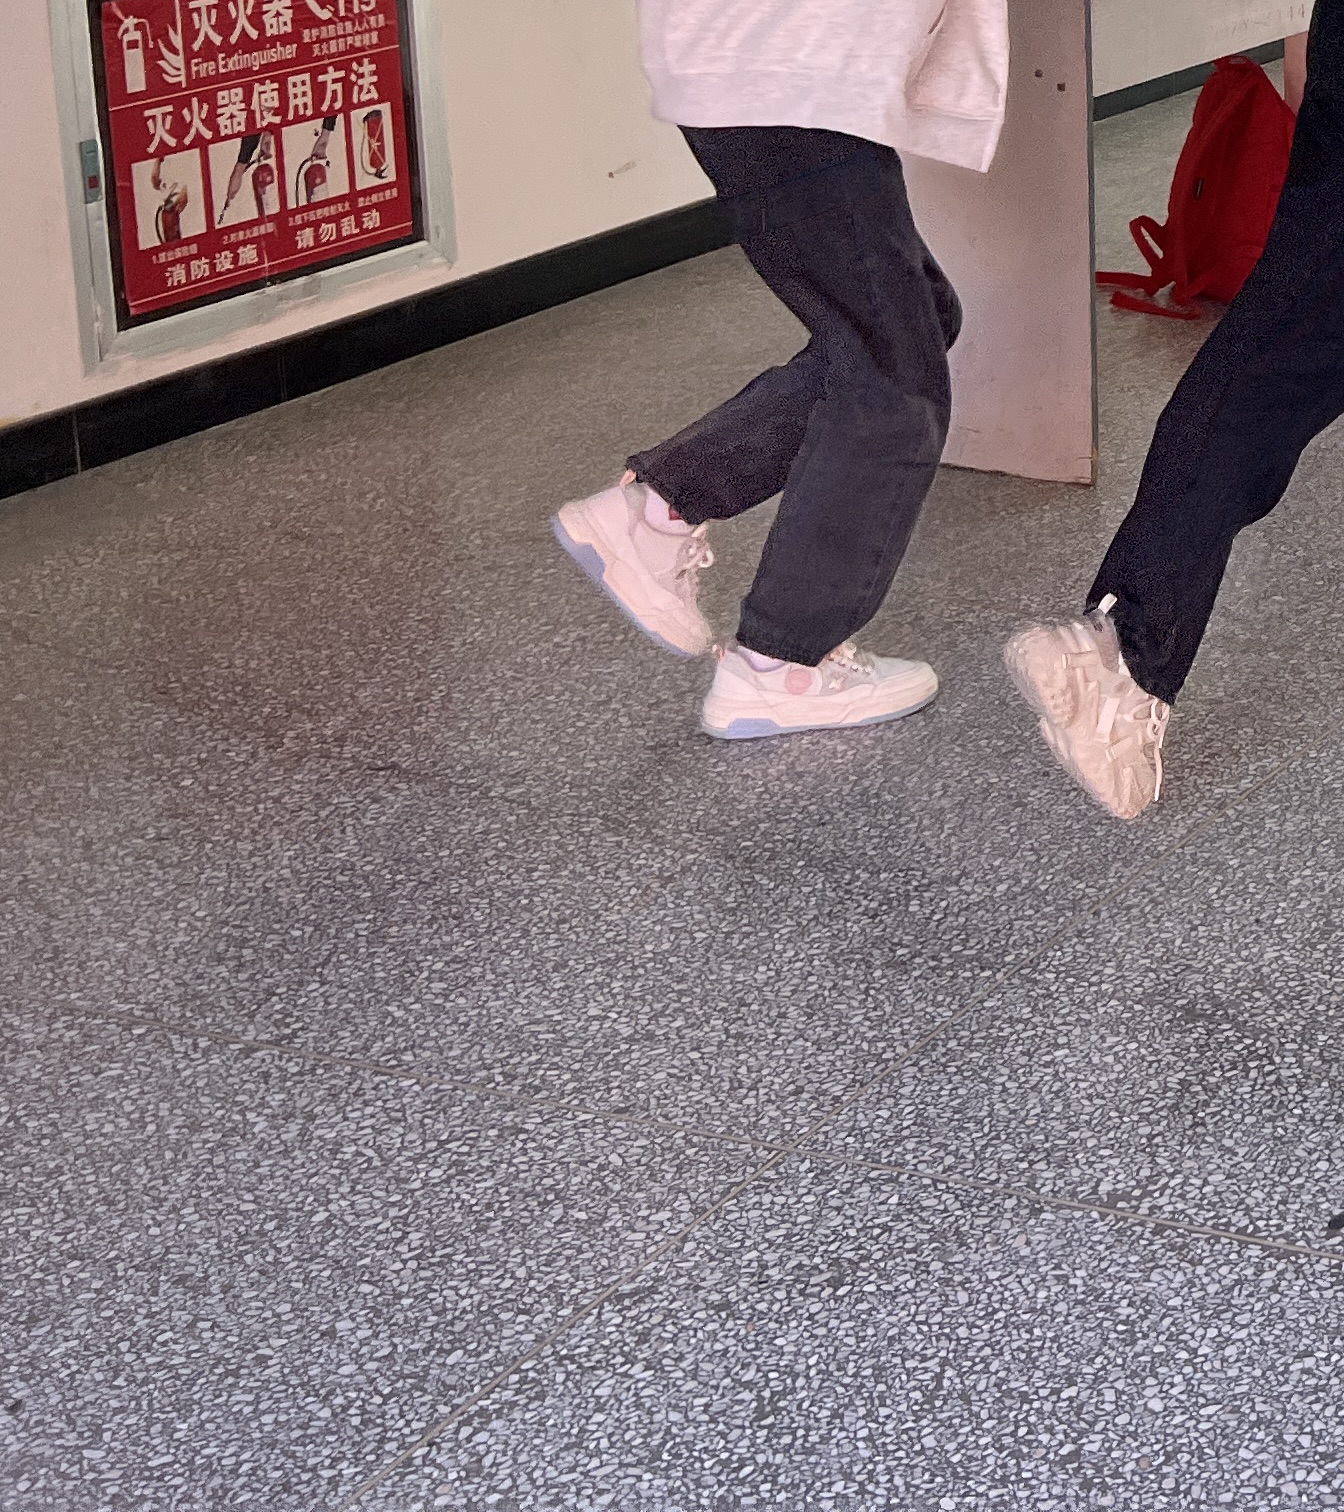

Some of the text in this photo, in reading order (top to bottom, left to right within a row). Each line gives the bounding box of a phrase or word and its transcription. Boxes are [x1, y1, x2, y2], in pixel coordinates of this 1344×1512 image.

[190, 41, 299, 80] Fire Extinguisher
[142, 58, 380, 154] 灭火器使用方法
[165, 243, 259, 287] 消防设施
[295, 208, 381, 249] 请勿乱动
